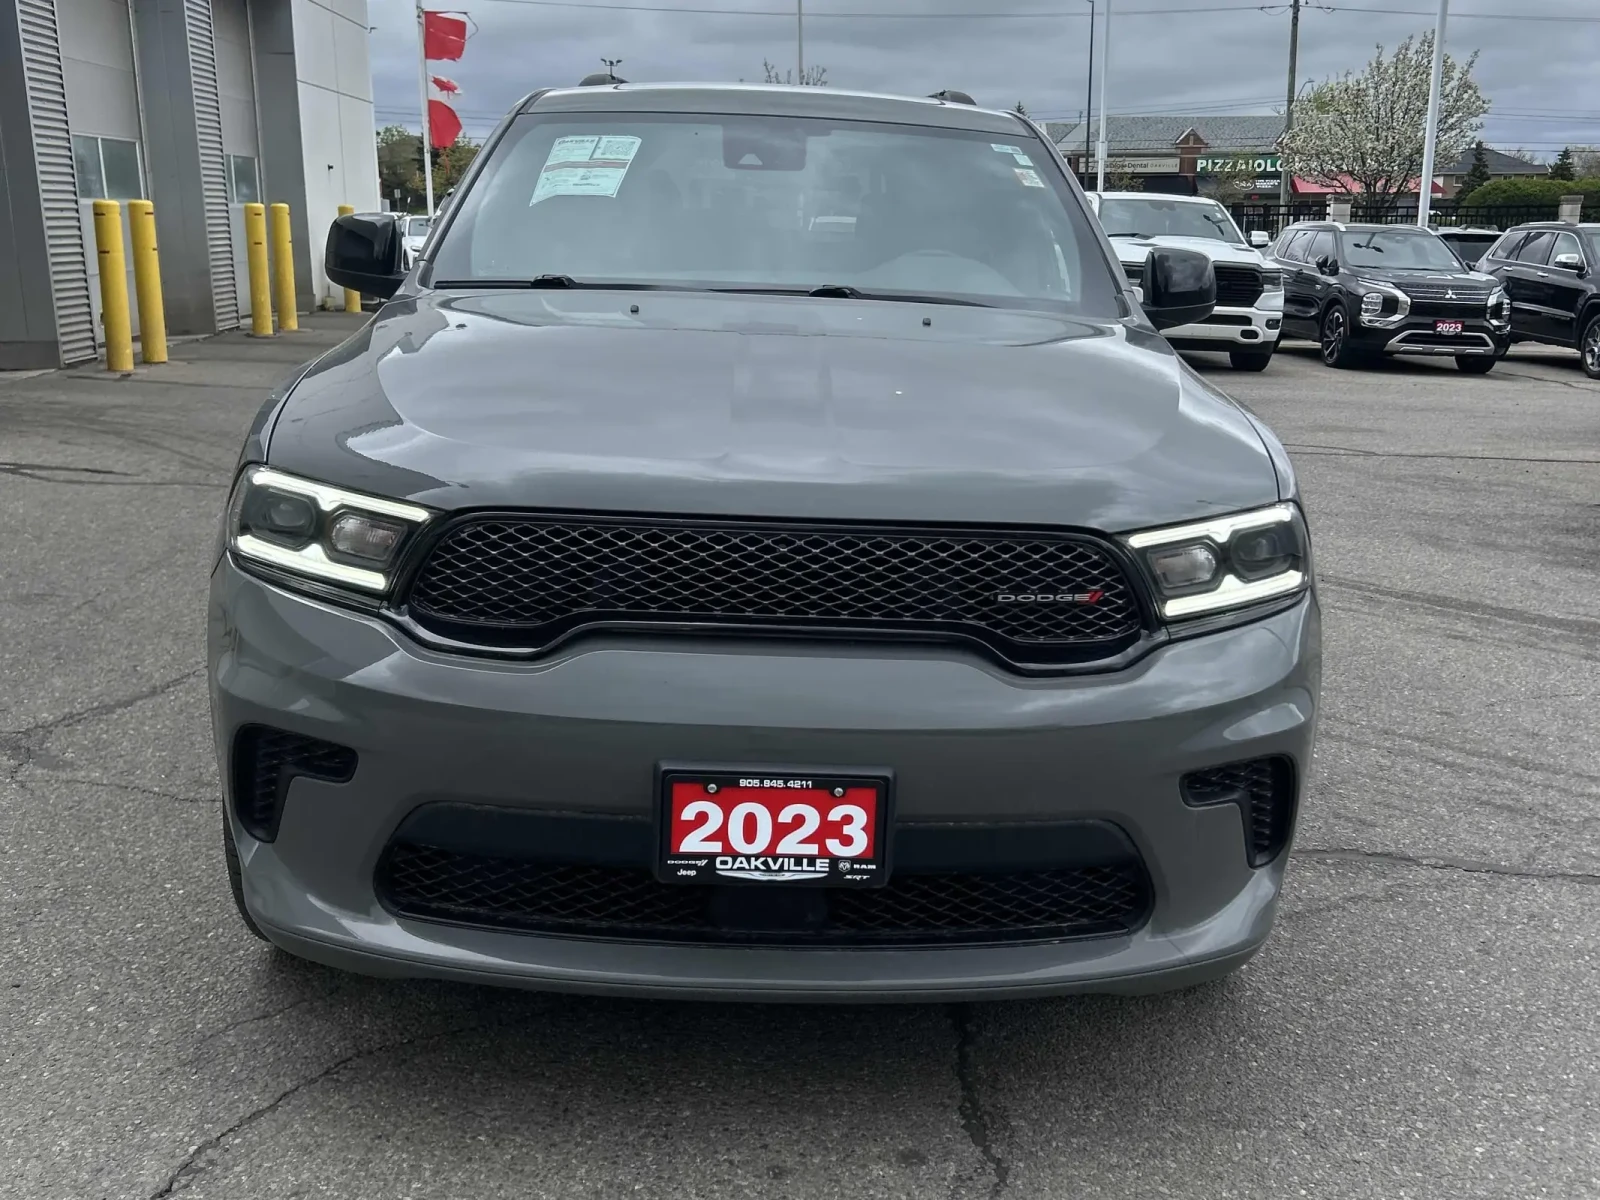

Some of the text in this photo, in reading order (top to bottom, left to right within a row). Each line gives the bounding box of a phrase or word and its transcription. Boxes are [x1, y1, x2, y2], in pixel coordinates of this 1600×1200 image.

[1436, 322, 1462, 332] 2023
[997, 593, 1091, 602] DODGE
[739, 779, 813, 789] 905.845.4211
[679, 800, 868, 857] 2023
[715, 856, 830, 871] OAKVILLE
[677, 868, 697, 876] Jeep
